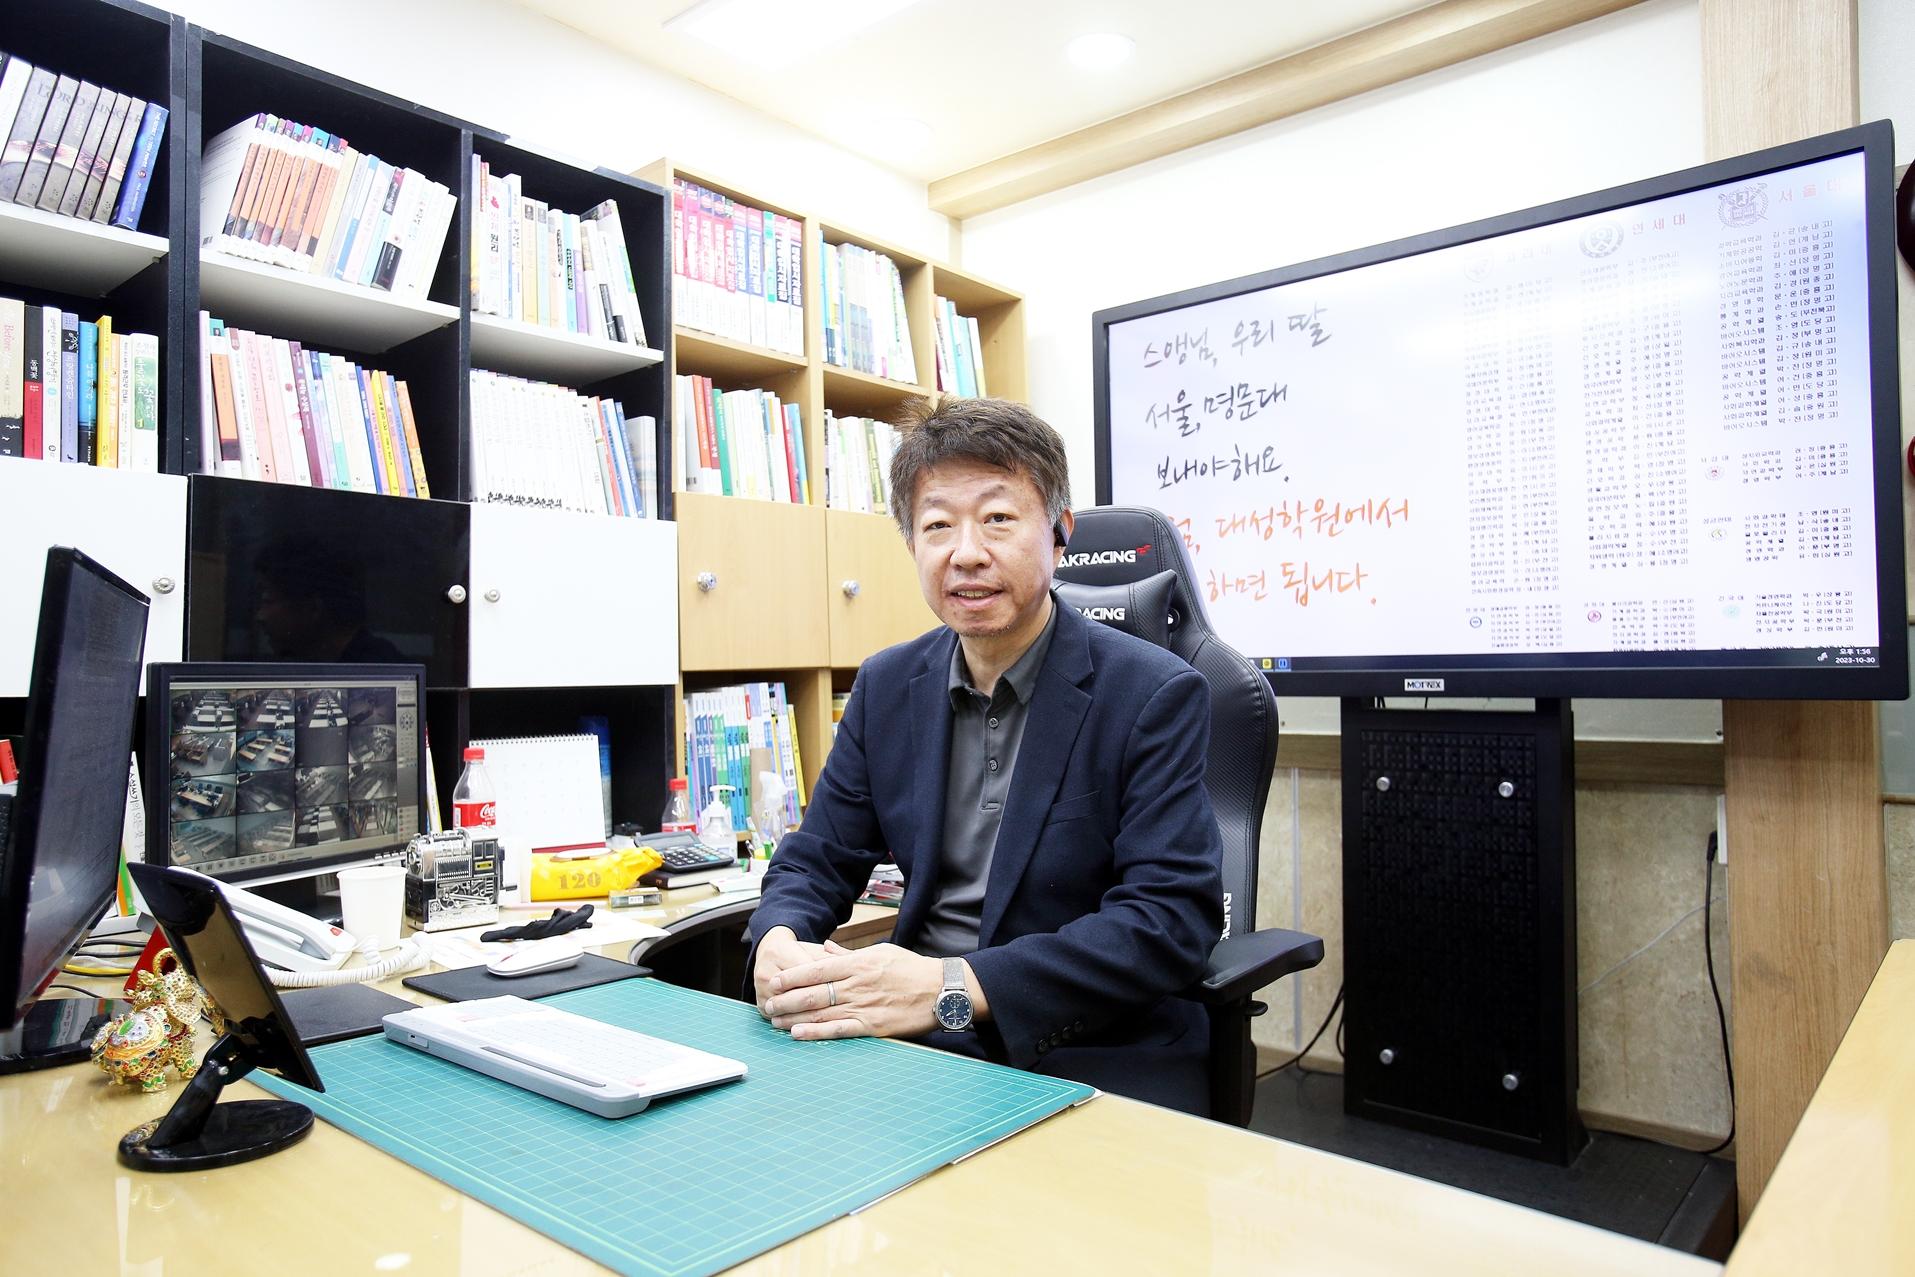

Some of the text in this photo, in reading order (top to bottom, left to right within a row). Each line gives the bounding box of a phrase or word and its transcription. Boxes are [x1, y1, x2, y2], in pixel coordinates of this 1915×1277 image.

[1232, 320, 1273, 356] 우리
[1288, 302, 1332, 347] 딸
[1215, 497, 1409, 541] 대성학원에서
[1206, 561, 1376, 607] 하면 됩니다.
[558, 872, 602, 890] 120
